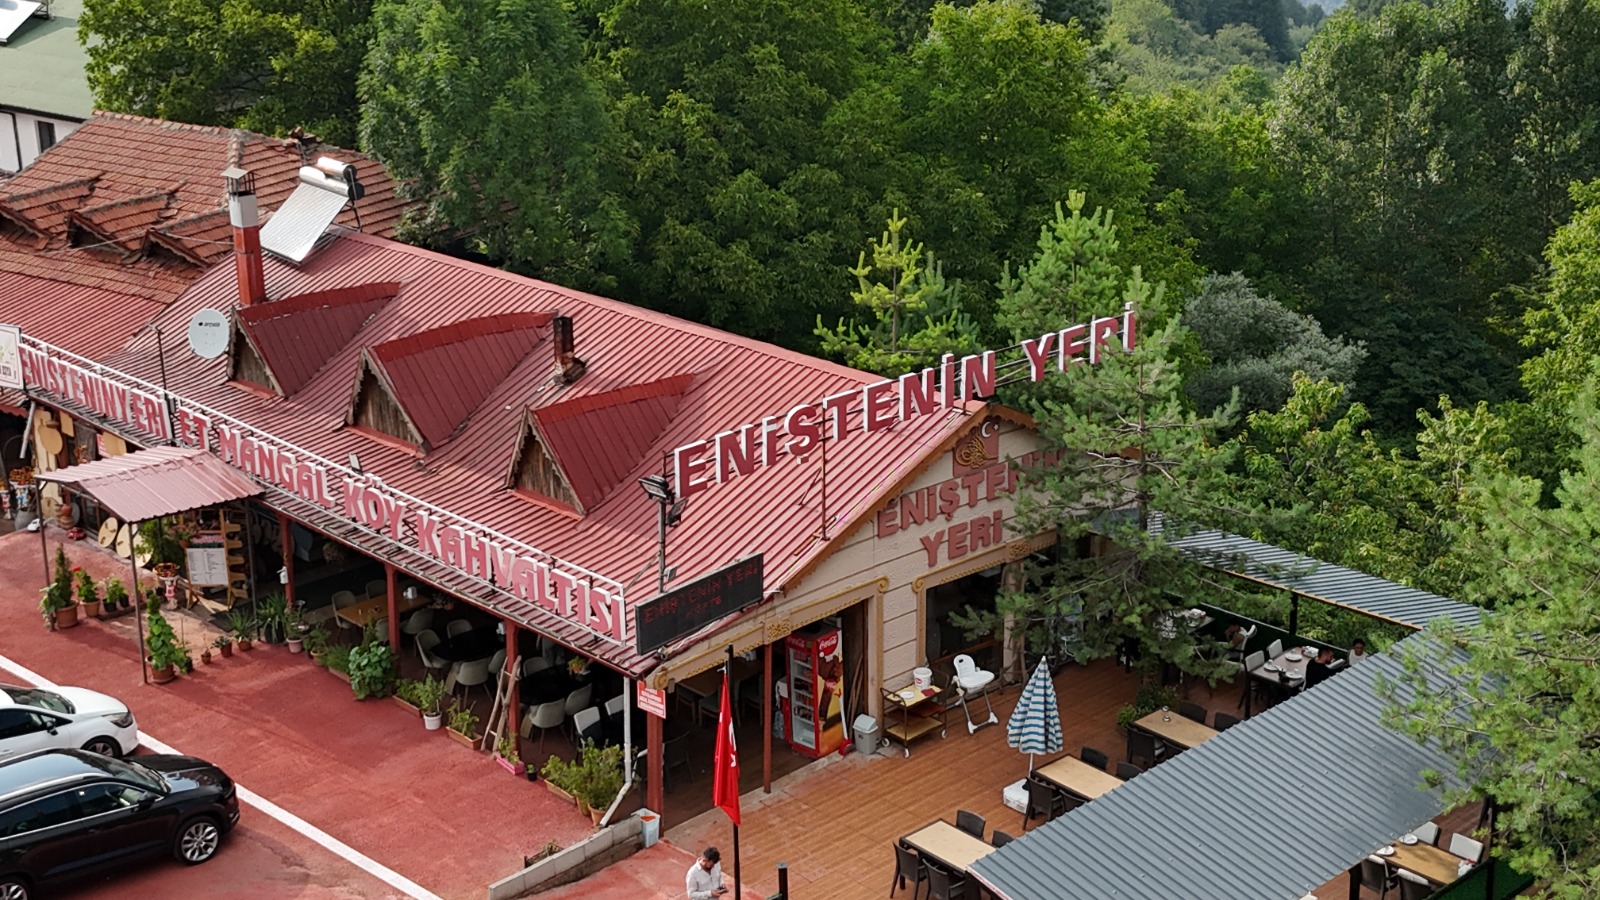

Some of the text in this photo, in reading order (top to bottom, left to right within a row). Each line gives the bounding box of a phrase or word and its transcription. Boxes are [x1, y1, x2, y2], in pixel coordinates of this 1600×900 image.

[674, 302, 1136, 498] ENİŞTENİN YERİ
[179, 406, 211, 451] ET
[219, 424, 336, 509] MANGAL
[342, 473, 407, 541] KÖY
[416, 509, 628, 643] KAHVALTISI
[919, 509, 1004, 568] YERİ
